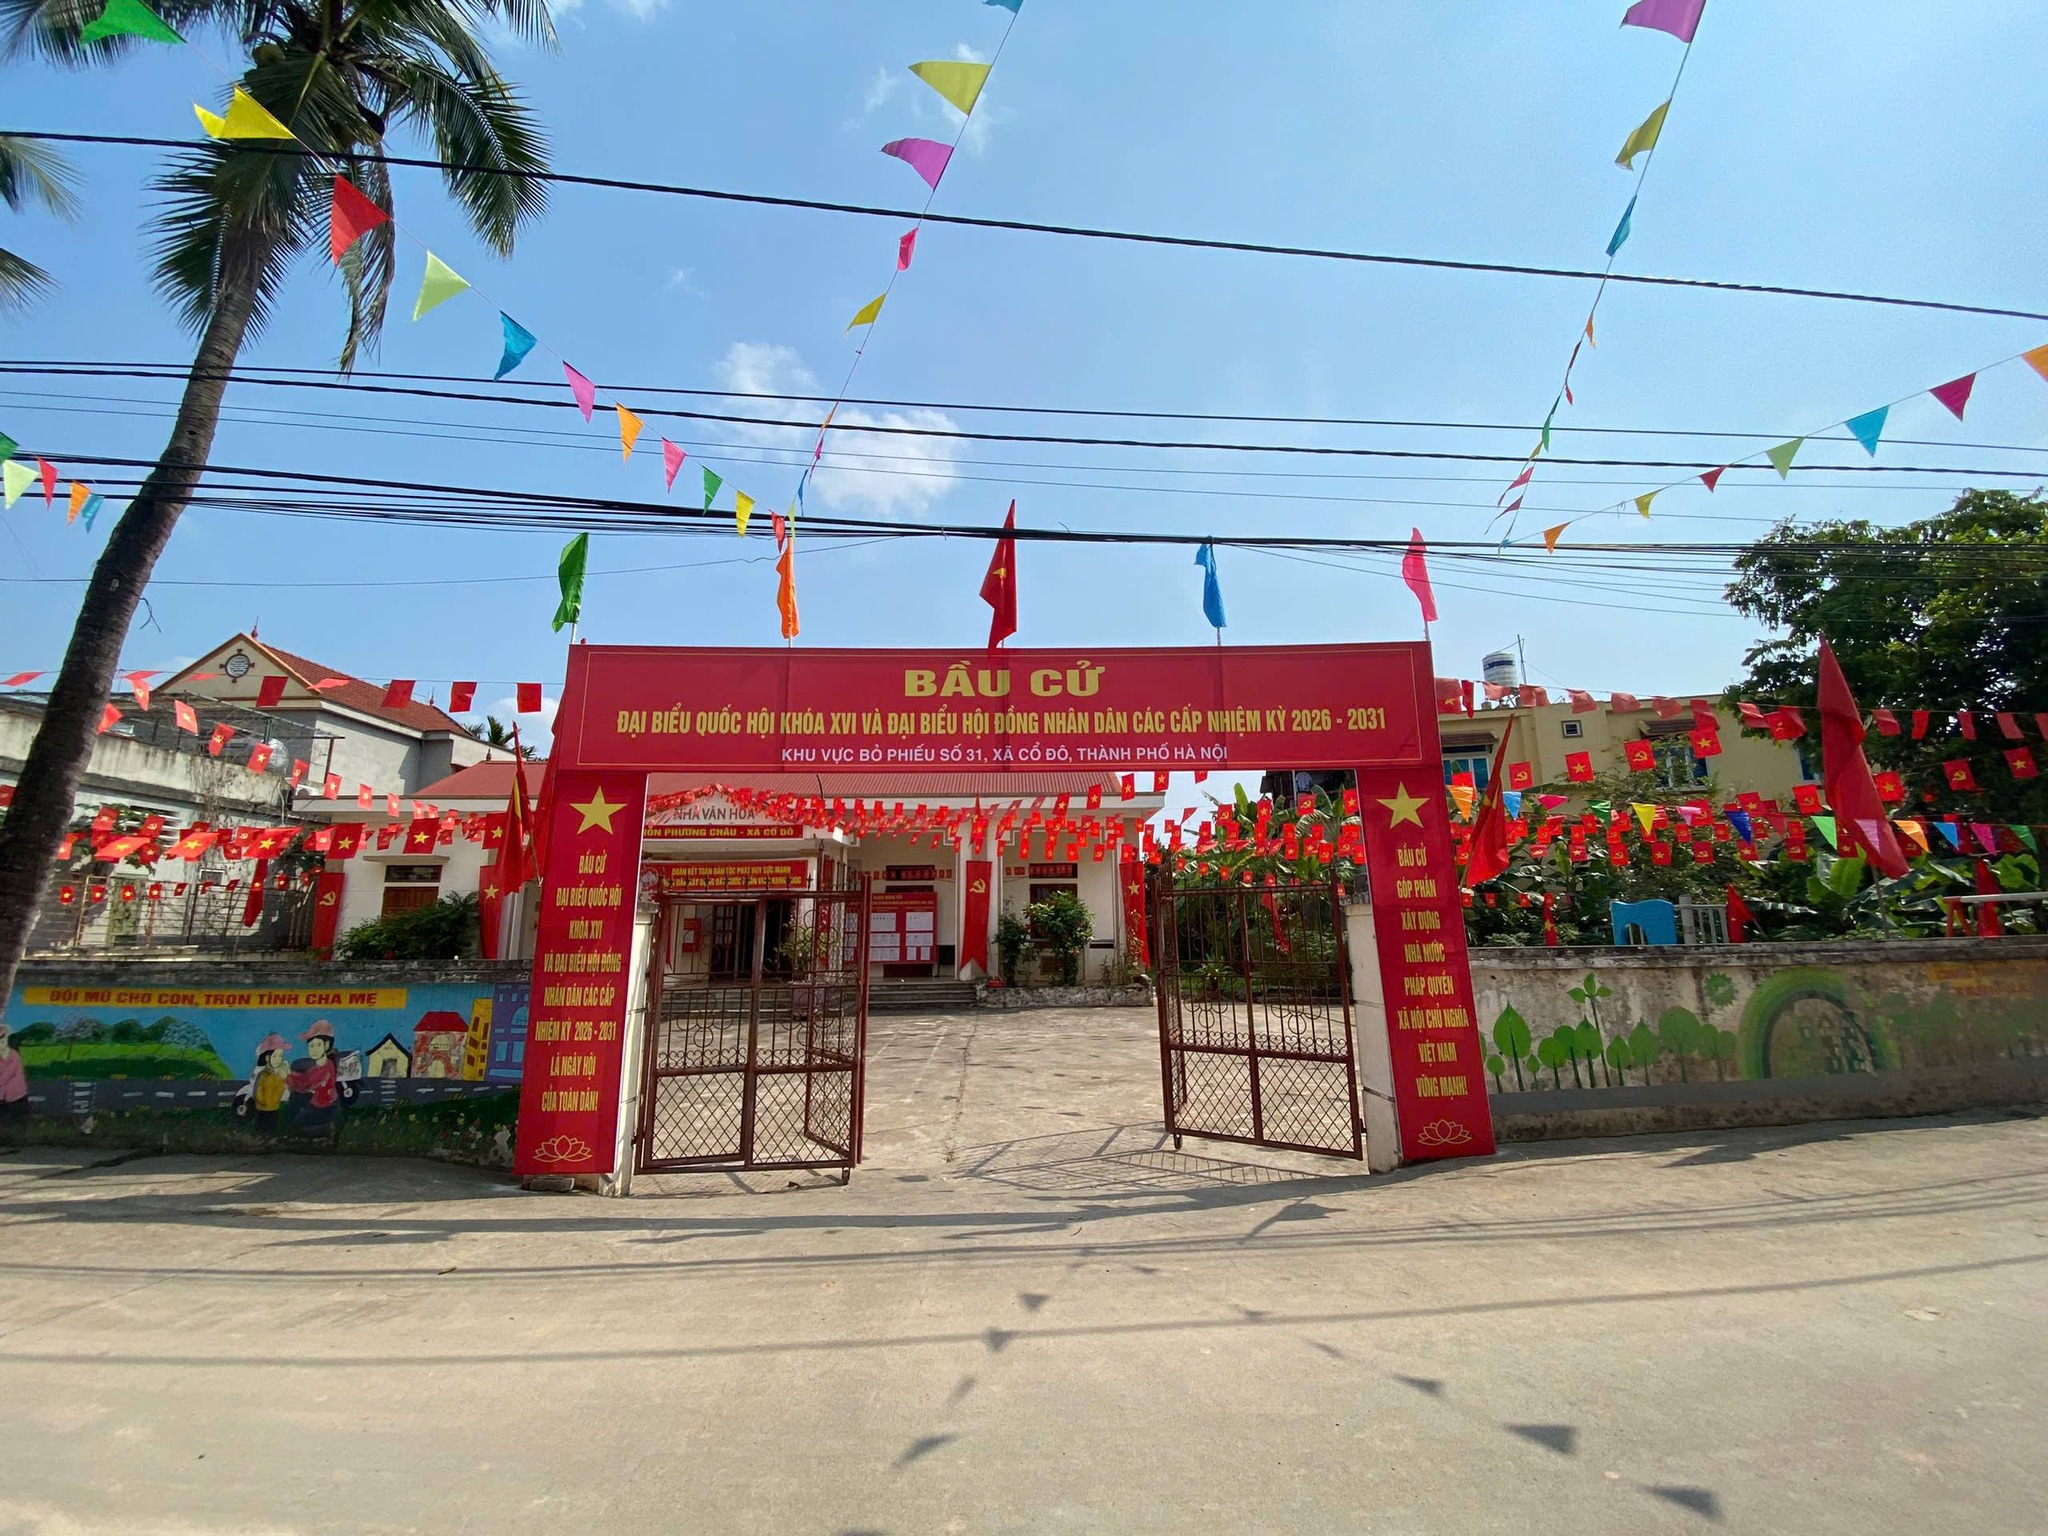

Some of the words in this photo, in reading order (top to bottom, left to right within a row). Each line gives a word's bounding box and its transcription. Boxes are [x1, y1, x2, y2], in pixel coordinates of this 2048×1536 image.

[904, 660, 1011, 698] BẦU
[1030, 659, 1105, 697] CỬ
[617, 710, 647, 738] ĐẠI
[651, 702, 691, 734] BIỂU
[696, 703, 742, 736] QUỐC
[746, 707, 775, 739] HỘI
[780, 707, 825, 734] KHÓA
[829, 712, 857, 734] XVI
[862, 708, 883, 734] VÀ
[887, 712, 916, 740] ĐẠI
[920, 703, 957, 734] BIỂU
[962, 708, 990, 739] HỘI
[994, 704, 1039, 734] ĐỒNG
[1044, 707, 1089, 734] NHÂN
[1094, 707, 1128, 733] DÂN
[1132, 707, 1165, 733] CÁC
[1170, 703, 1203, 733] CẤP
[1207, 705, 1262, 737] NHIỆM
[1265, 705, 1287, 732] KỲ
[1291, 708, 1332, 732] 2026
[1347, 707, 1386, 731] 2031
[781, 748, 816, 761] KHU
[821, 747, 854, 764] VỰC
[859, 744, 883, 761] BỎ
[887, 743, 935, 761] PHIẾU
[939, 743, 962, 761] SỐ
[966, 748, 988, 763] 31,
[992, 745, 1014, 761] XÃ
[1018, 741, 1042, 761] CỔ
[1045, 745, 1073, 763] ĐÔ,
[1077, 744, 1131, 761] THÀNH
[1136, 742, 1170, 760] PHỐ
[1174, 744, 1196, 760] HÀ
[1200, 743, 1227, 762] NỘI
[702, 805, 726, 820] VĂN
[664, 827, 706, 837] PHƯƠNG
[578, 849, 595, 874] BẦU
[595, 849, 607, 873] CỬ
[1397, 842, 1414, 867] BẦU
[1415, 842, 1427, 867] CỬ
[556, 887, 570, 910] ĐẠI
[570, 881, 586, 906] BIỂU
[588, 881, 608, 908] QUỐC
[609, 884, 622, 910] HỘI
[1396, 875, 1413, 898] GÓP
[1414, 873, 1437, 898] PHẦN
[569, 916, 588, 939] KHÓA
[589, 920, 603, 939] XVI
[1401, 908, 1417, 931] XÂY
[1418, 910, 1440, 933] DỰNG
[543, 949, 554, 972] VÀ
[554, 953, 568, 976] ĐẠI
[568, 946, 586, 972] BIỂU
[586, 949, 600, 976] HỘI
[600, 946, 622, 972] ĐỒNG
[1404, 940, 1422, 963] NHÀ
[1423, 939, 1445, 963] NƯỚC
[543, 983, 565, 1006] NHÂN
[566, 983, 582, 1006] DÂN
[583, 983, 599, 1006] CÁC
[600, 980, 615, 1006] CẤP
[1404, 973, 1426, 996] PHÁP
[1427, 970, 1454, 997] QUYỀN
[50, 989, 79, 1004] ĐỘI
[84, 989, 111, 1003] MŨ
[116, 992, 153, 1004] CHO
[157, 993, 199, 1006] CON,
[203, 993, 252, 1007] TRỌN
[257, 991, 300, 1005] TÌNH
[304, 993, 342, 1005] CHA
[348, 992, 377, 1007] MẸ
[535, 1017, 560, 1045] NHIỆM
[560, 1017, 571, 1041] KỲ
[574, 1022, 593, 1041] 2026
[599, 1021, 617, 1041] 2031
[1397, 1006, 1410, 1030] XÃ
[1411, 1005, 1425, 1033] HỘI
[1426, 1003, 1442, 1029] CHỦ
[1444, 1004, 1470, 1028] NGHĨA
[550, 1051, 560, 1076] LÀ
[560, 1051, 582, 1076] NGÀY
[582, 1051, 596, 1080] HỘI
[1418, 1039, 1436, 1067] VIỆT
[1437, 1042, 1457, 1062] NAM
[541, 1085, 557, 1111] CỦA
[558, 1086, 579, 1111] TOÀN
[579, 1086, 598, 1111] DÂN!
[1416, 1074, 1439, 1098] VỮNG
[1440, 1075, 1468, 1100] MẠNH!
